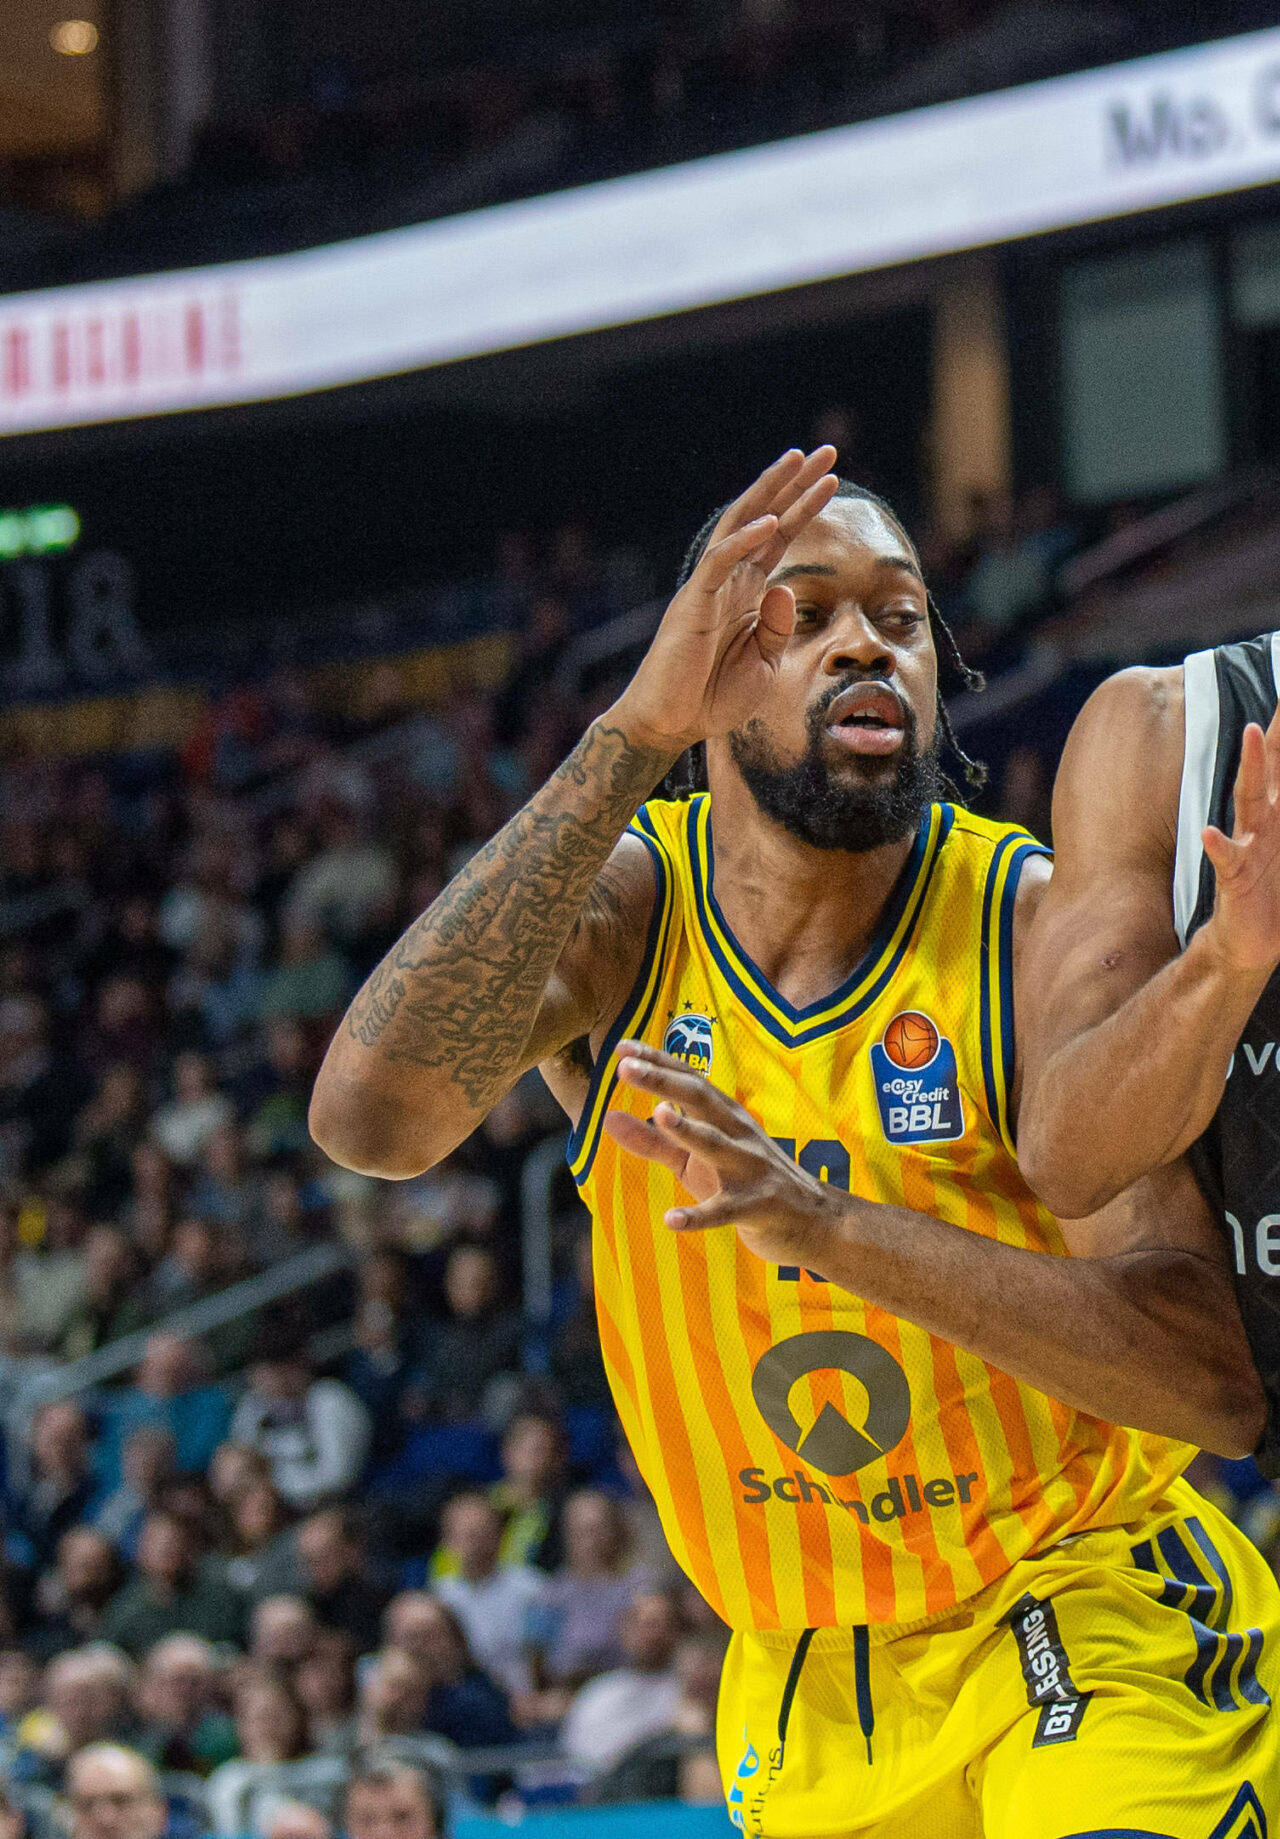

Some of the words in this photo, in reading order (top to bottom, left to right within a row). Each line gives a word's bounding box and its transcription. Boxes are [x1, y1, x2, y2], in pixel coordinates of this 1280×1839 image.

[902, 1087, 949, 1104] Credit
[889, 1103, 951, 1134] BBL
[738, 1468, 978, 1525] Schndler
